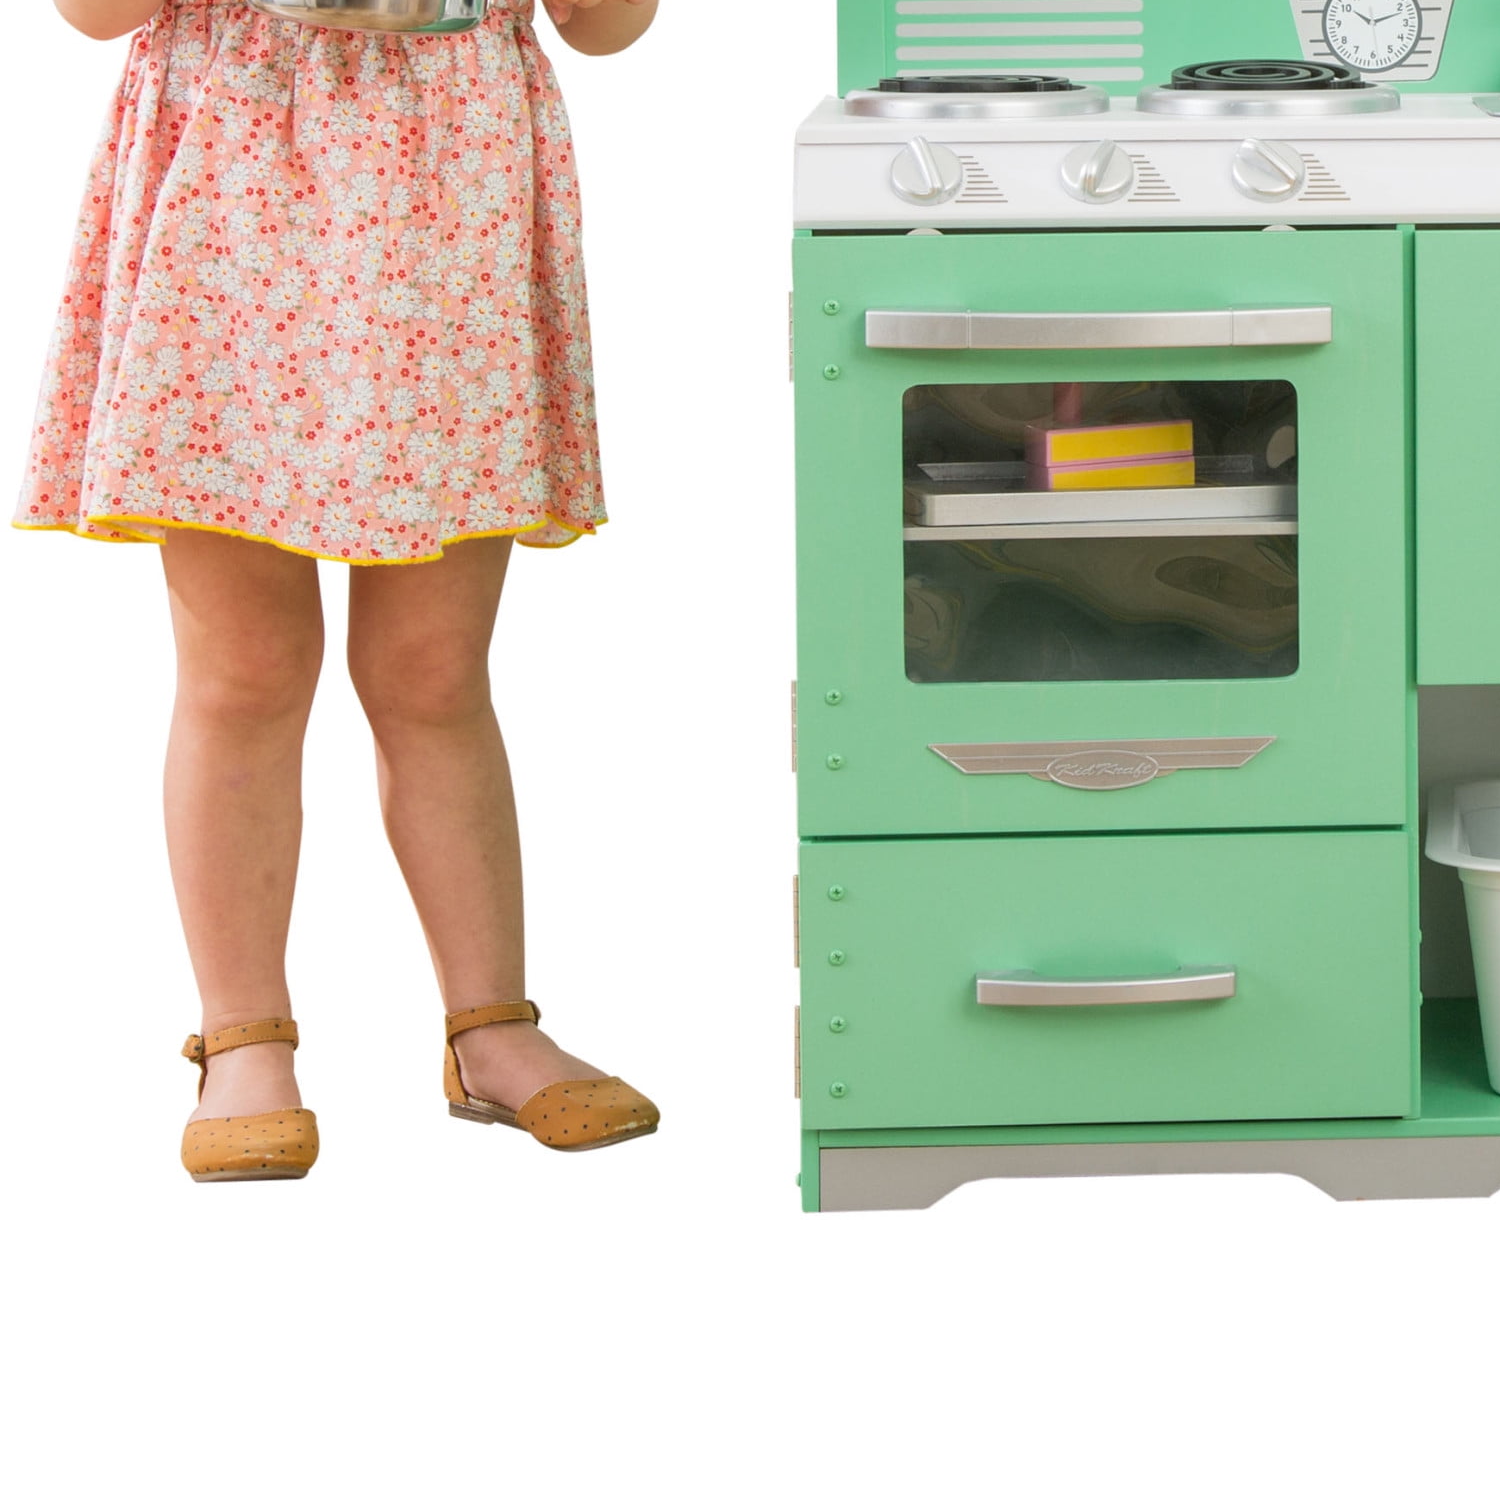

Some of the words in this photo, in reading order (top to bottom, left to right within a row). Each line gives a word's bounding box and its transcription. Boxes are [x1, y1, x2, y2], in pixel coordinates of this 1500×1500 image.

[1341, 4, 1352, 12] 10
[1396, 3, 1403, 11] 2
[1335, 20, 1342, 28] 9
[1402, 19, 1409, 27] 3
[1341, 36, 1347, 45] 8
[1397, 33, 1404, 41] 4
[1353, 45, 1360, 54] 7
[1387, 45, 1393, 54] 5
[1370, 50, 1376, 59] 6
